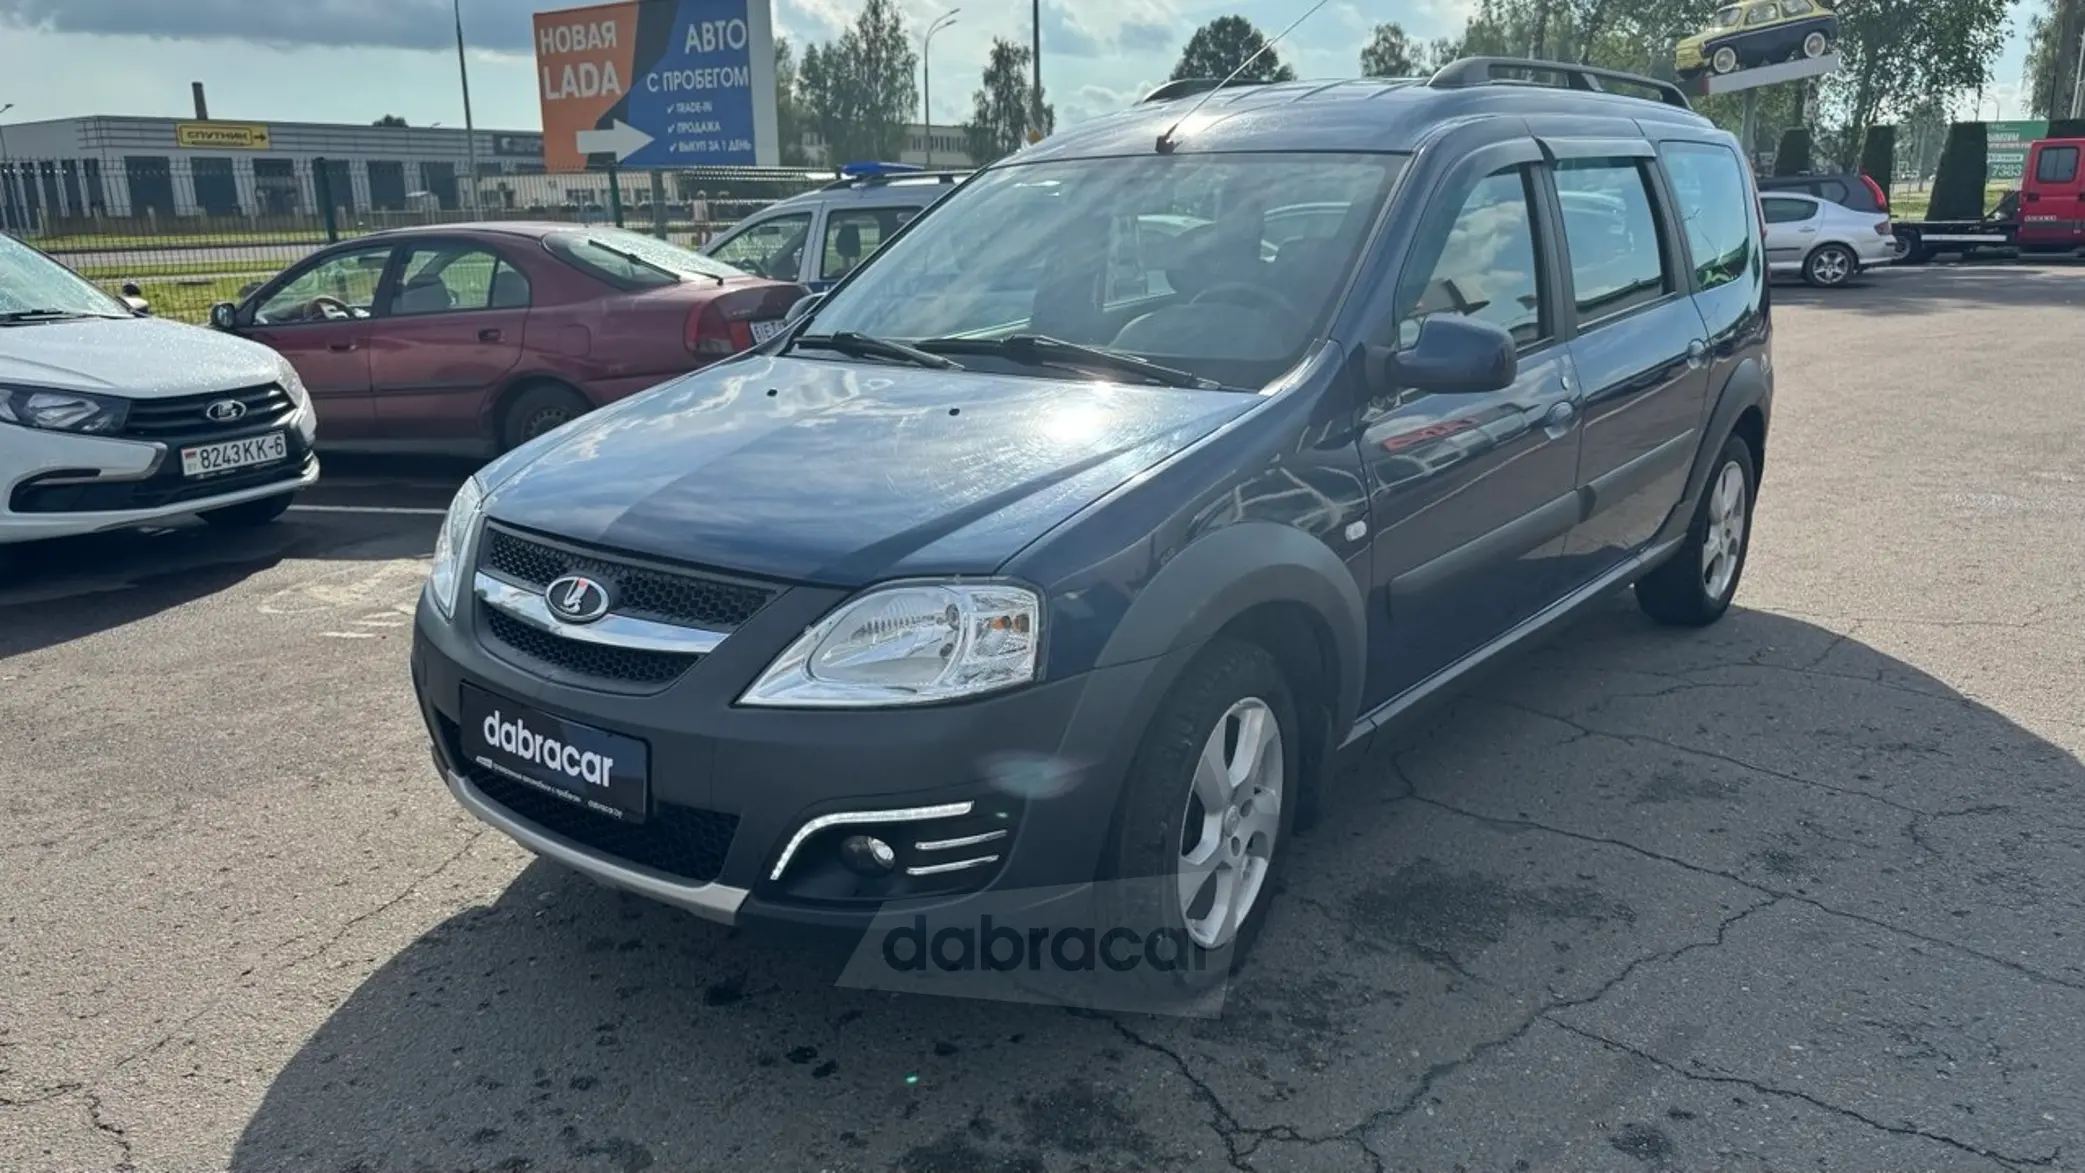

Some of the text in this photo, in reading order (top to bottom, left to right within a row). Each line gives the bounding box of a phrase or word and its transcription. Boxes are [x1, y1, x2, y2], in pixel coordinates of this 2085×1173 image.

[540, 20, 617, 55] НОВАЯ
[685, 18, 748, 54] АВТО
[543, 60, 621, 100] LADA
[646, 66, 749, 93] С ПРОБЕГОМ
[675, 102, 713, 114] TRADE-IN
[677, 121, 721, 135] ПРОДАЖА
[679, 140, 706, 153] ВЫКУП
[708, 140, 720, 152] ЗА
[728, 140, 752, 152] ДЕНЬ
[200, 436, 284, 469] 8243KK-6
[483, 710, 613, 787] dabracar
